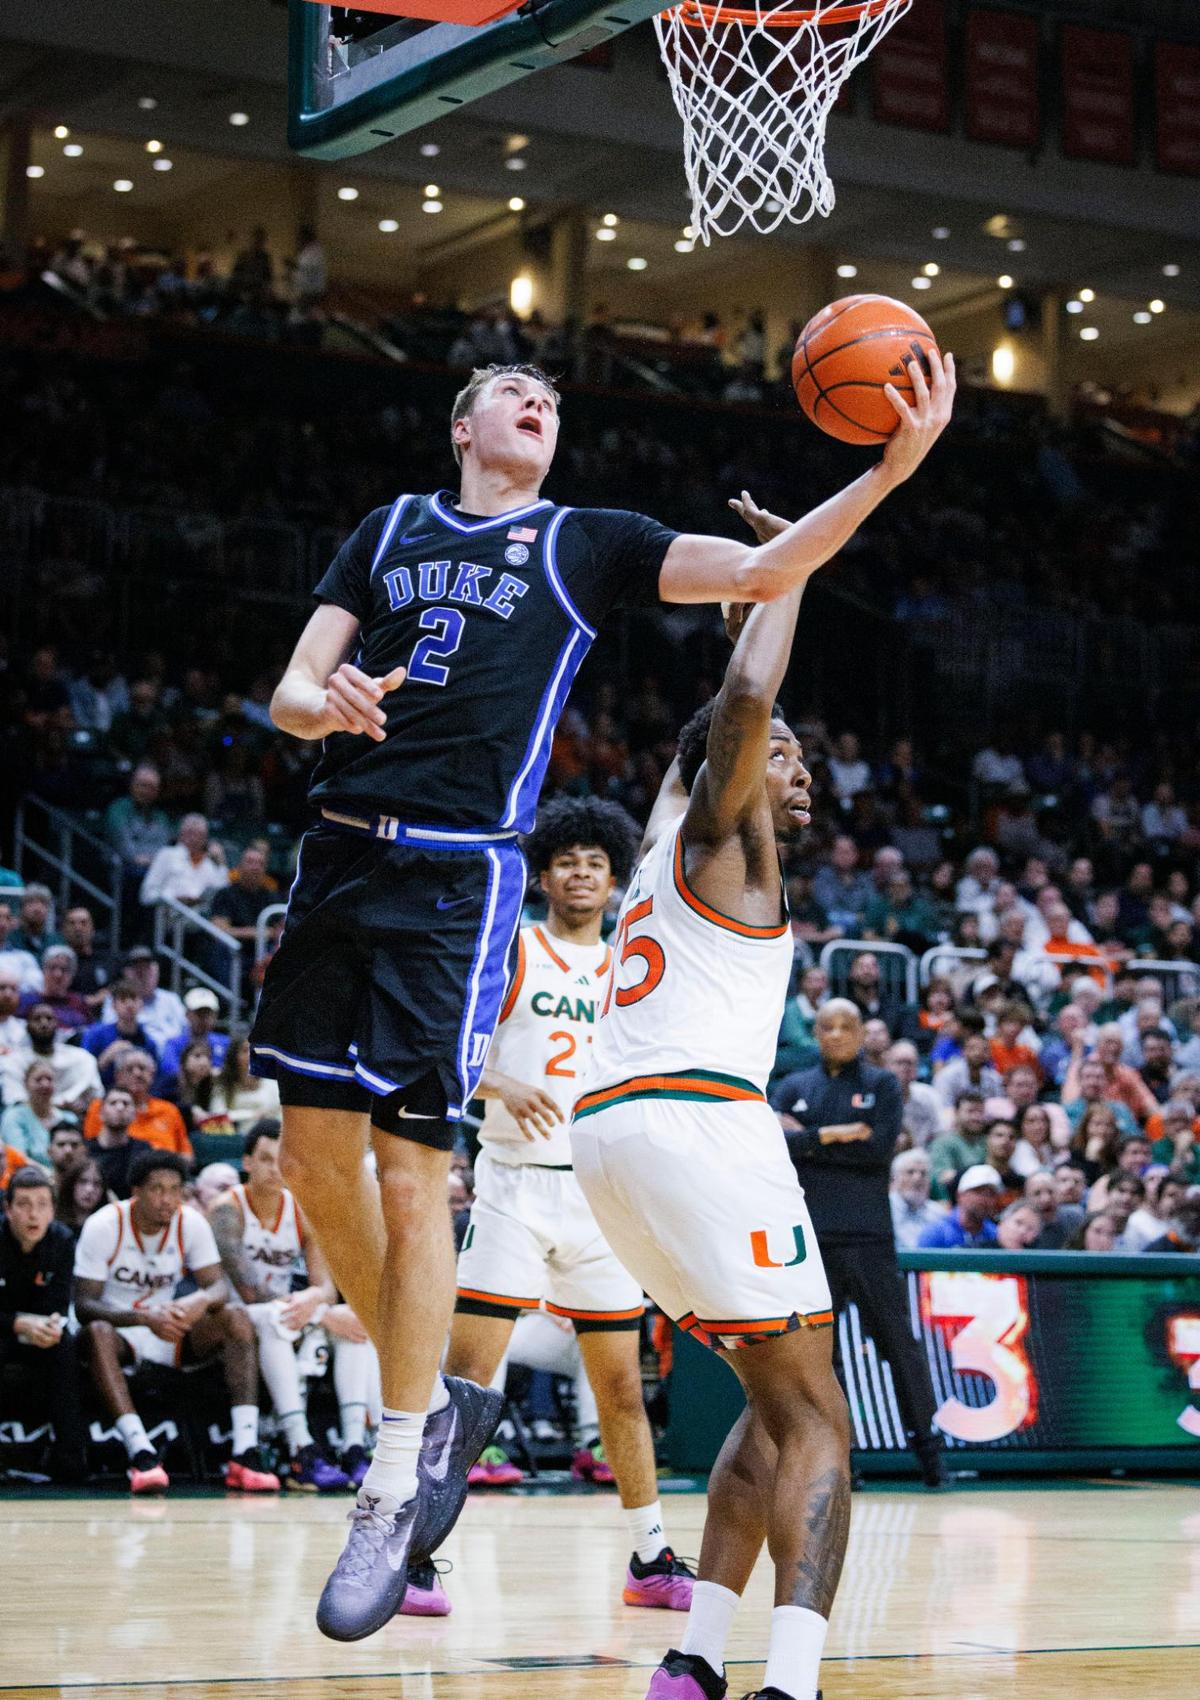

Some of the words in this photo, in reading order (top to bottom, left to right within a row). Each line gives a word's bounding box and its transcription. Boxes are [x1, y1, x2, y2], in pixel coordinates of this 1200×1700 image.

[383, 560, 530, 620] DUKE
[406, 606, 466, 686] 2
[530, 991, 600, 1024] CAN
[544, 1030, 593, 1078] 2
[750, 1224, 807, 1268] U
[923, 1270, 1037, 1443] 3
